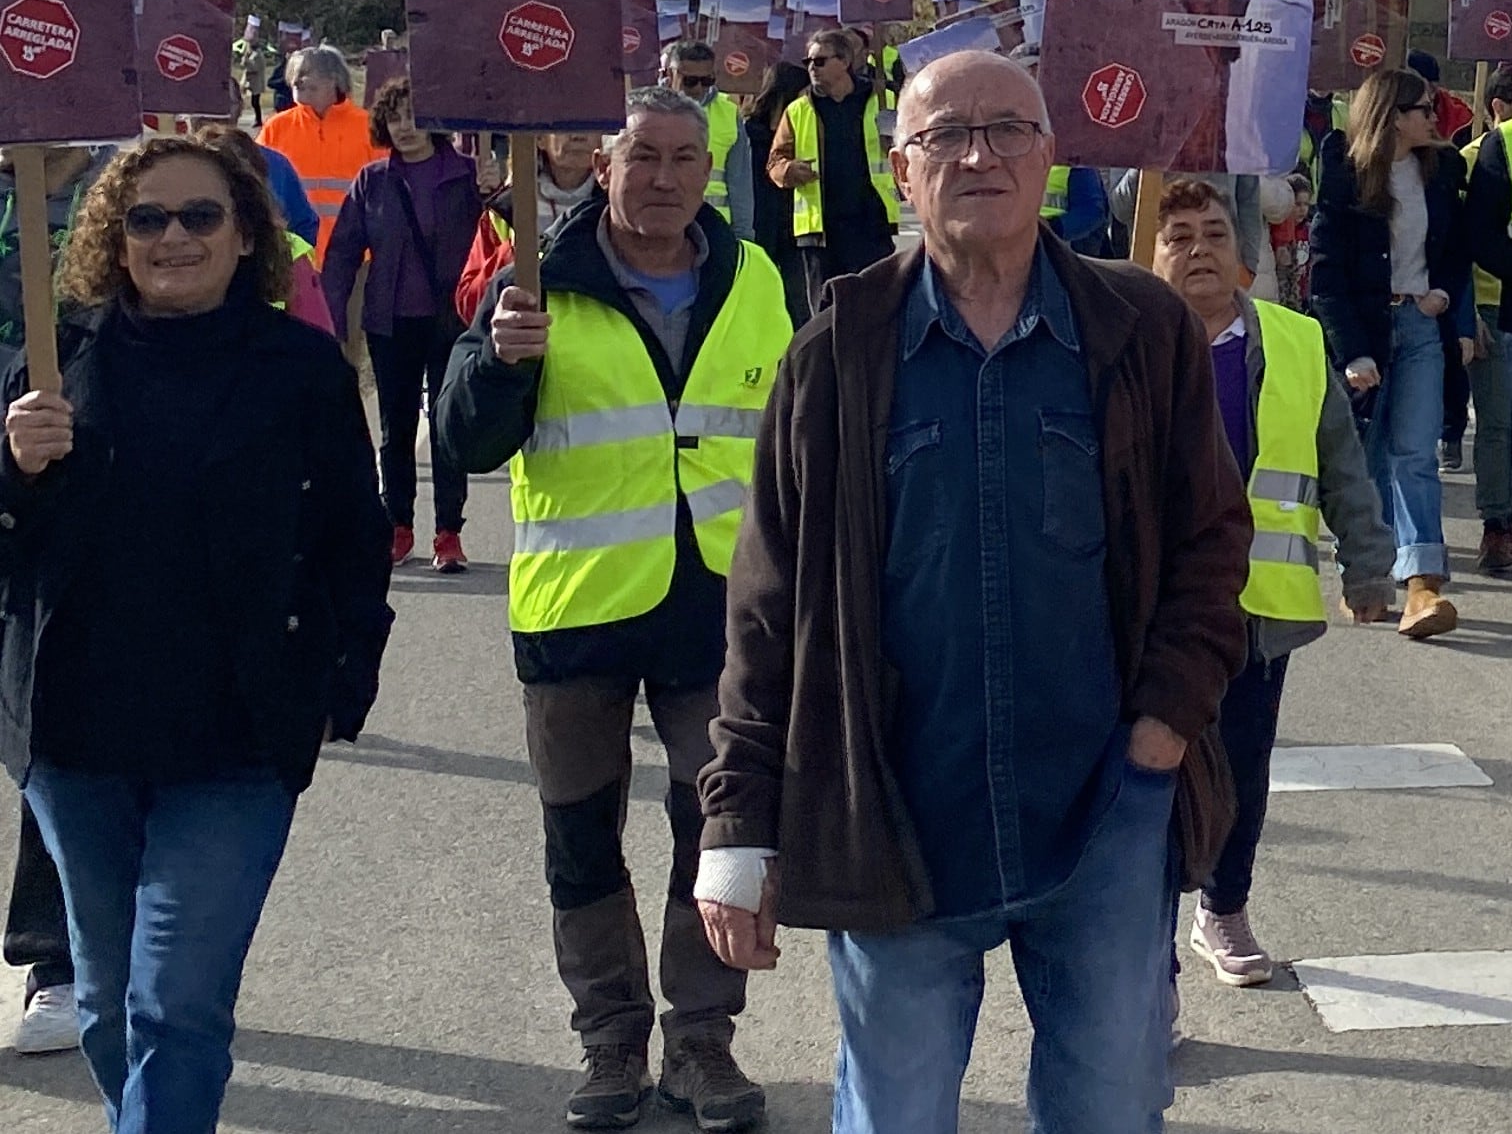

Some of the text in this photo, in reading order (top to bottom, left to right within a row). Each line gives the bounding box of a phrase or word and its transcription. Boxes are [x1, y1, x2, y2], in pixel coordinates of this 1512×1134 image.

[3, 25, 73, 52] ARREGLADA
[6, 13, 74, 39] CARRETERA
[508, 15, 569, 41] CARRETERA
